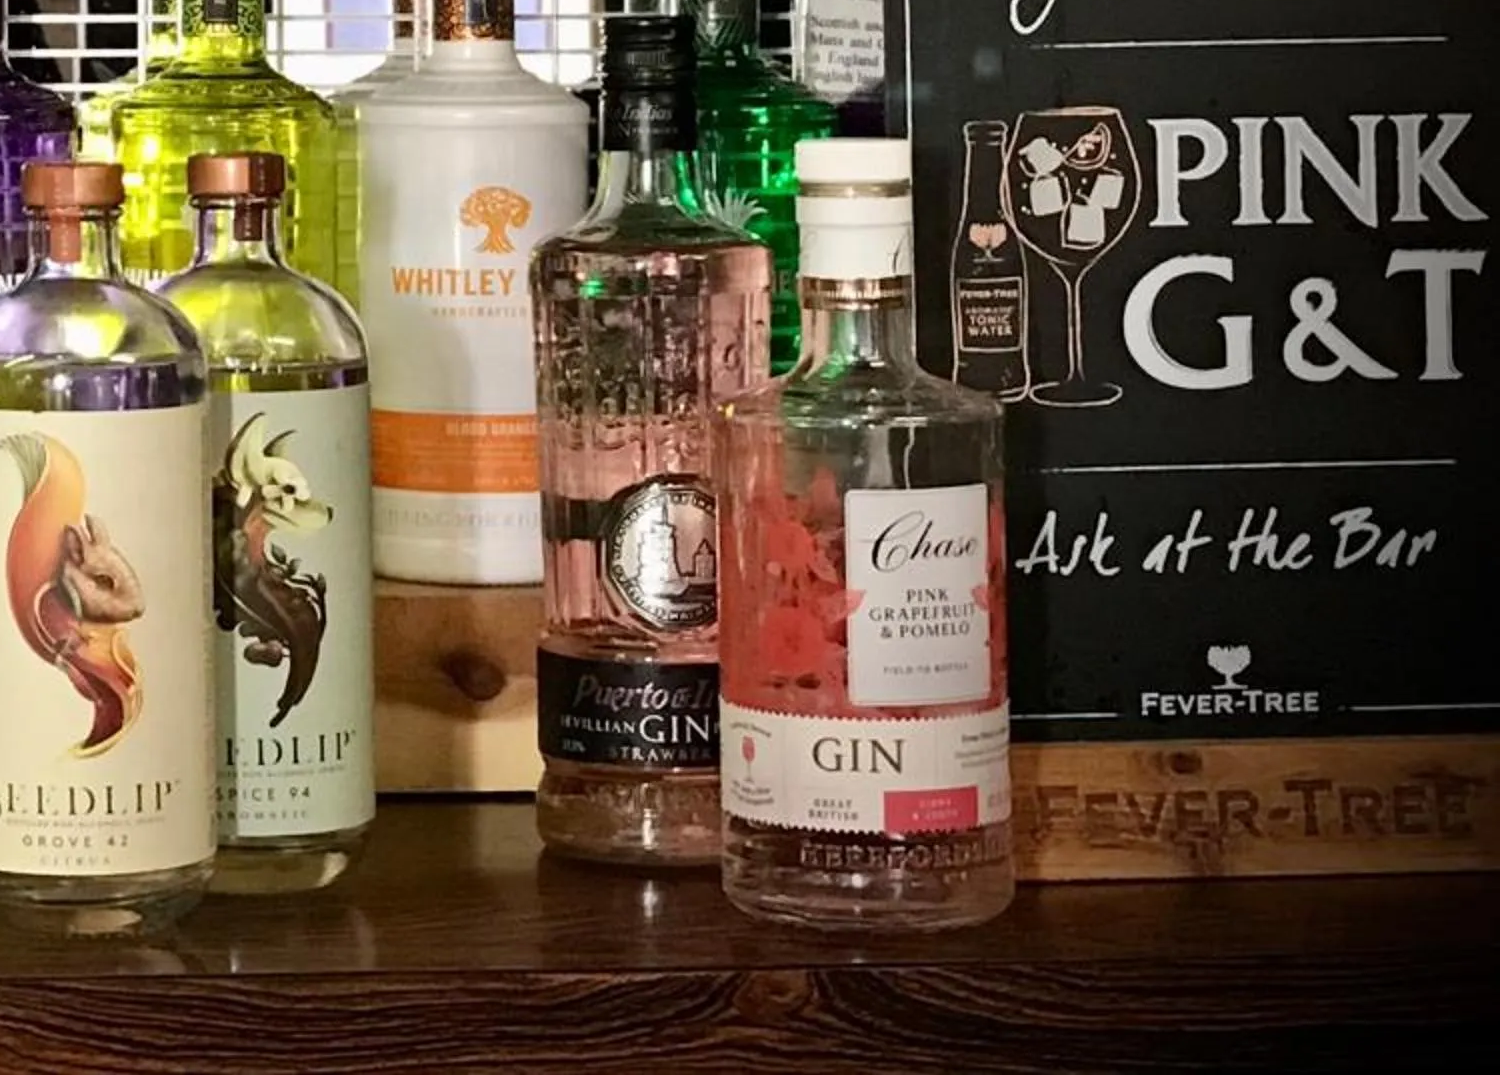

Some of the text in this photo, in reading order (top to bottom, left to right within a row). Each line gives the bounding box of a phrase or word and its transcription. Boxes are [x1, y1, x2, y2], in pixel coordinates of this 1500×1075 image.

[1146, 113, 1490, 229] PINK
[391, 266, 517, 296] WHITLEY
[968, 325, 1013, 337] WATER
[969, 314, 1010, 325] TONIC
[1122, 249, 1487, 391] G&T
[857, 510, 978, 573] Chase
[1015, 506, 1438, 578] Ask at the Bar
[905, 588, 949, 604] PINK
[868, 602, 977, 623] GRAPEFRUIT
[879, 621, 971, 639] & POMELO
[573, 675, 670, 712] Puerto
[1140, 690, 1320, 717] FEVER-TREE
[639, 713, 710, 744] GIN
[226, 731, 351, 766] EDLIP
[609, 745, 713, 762] STRAWBER
[812, 737, 906, 774] GIN
[216, 786, 311, 803] SPICE 94
[22, 833, 129, 848] GROVE 42
